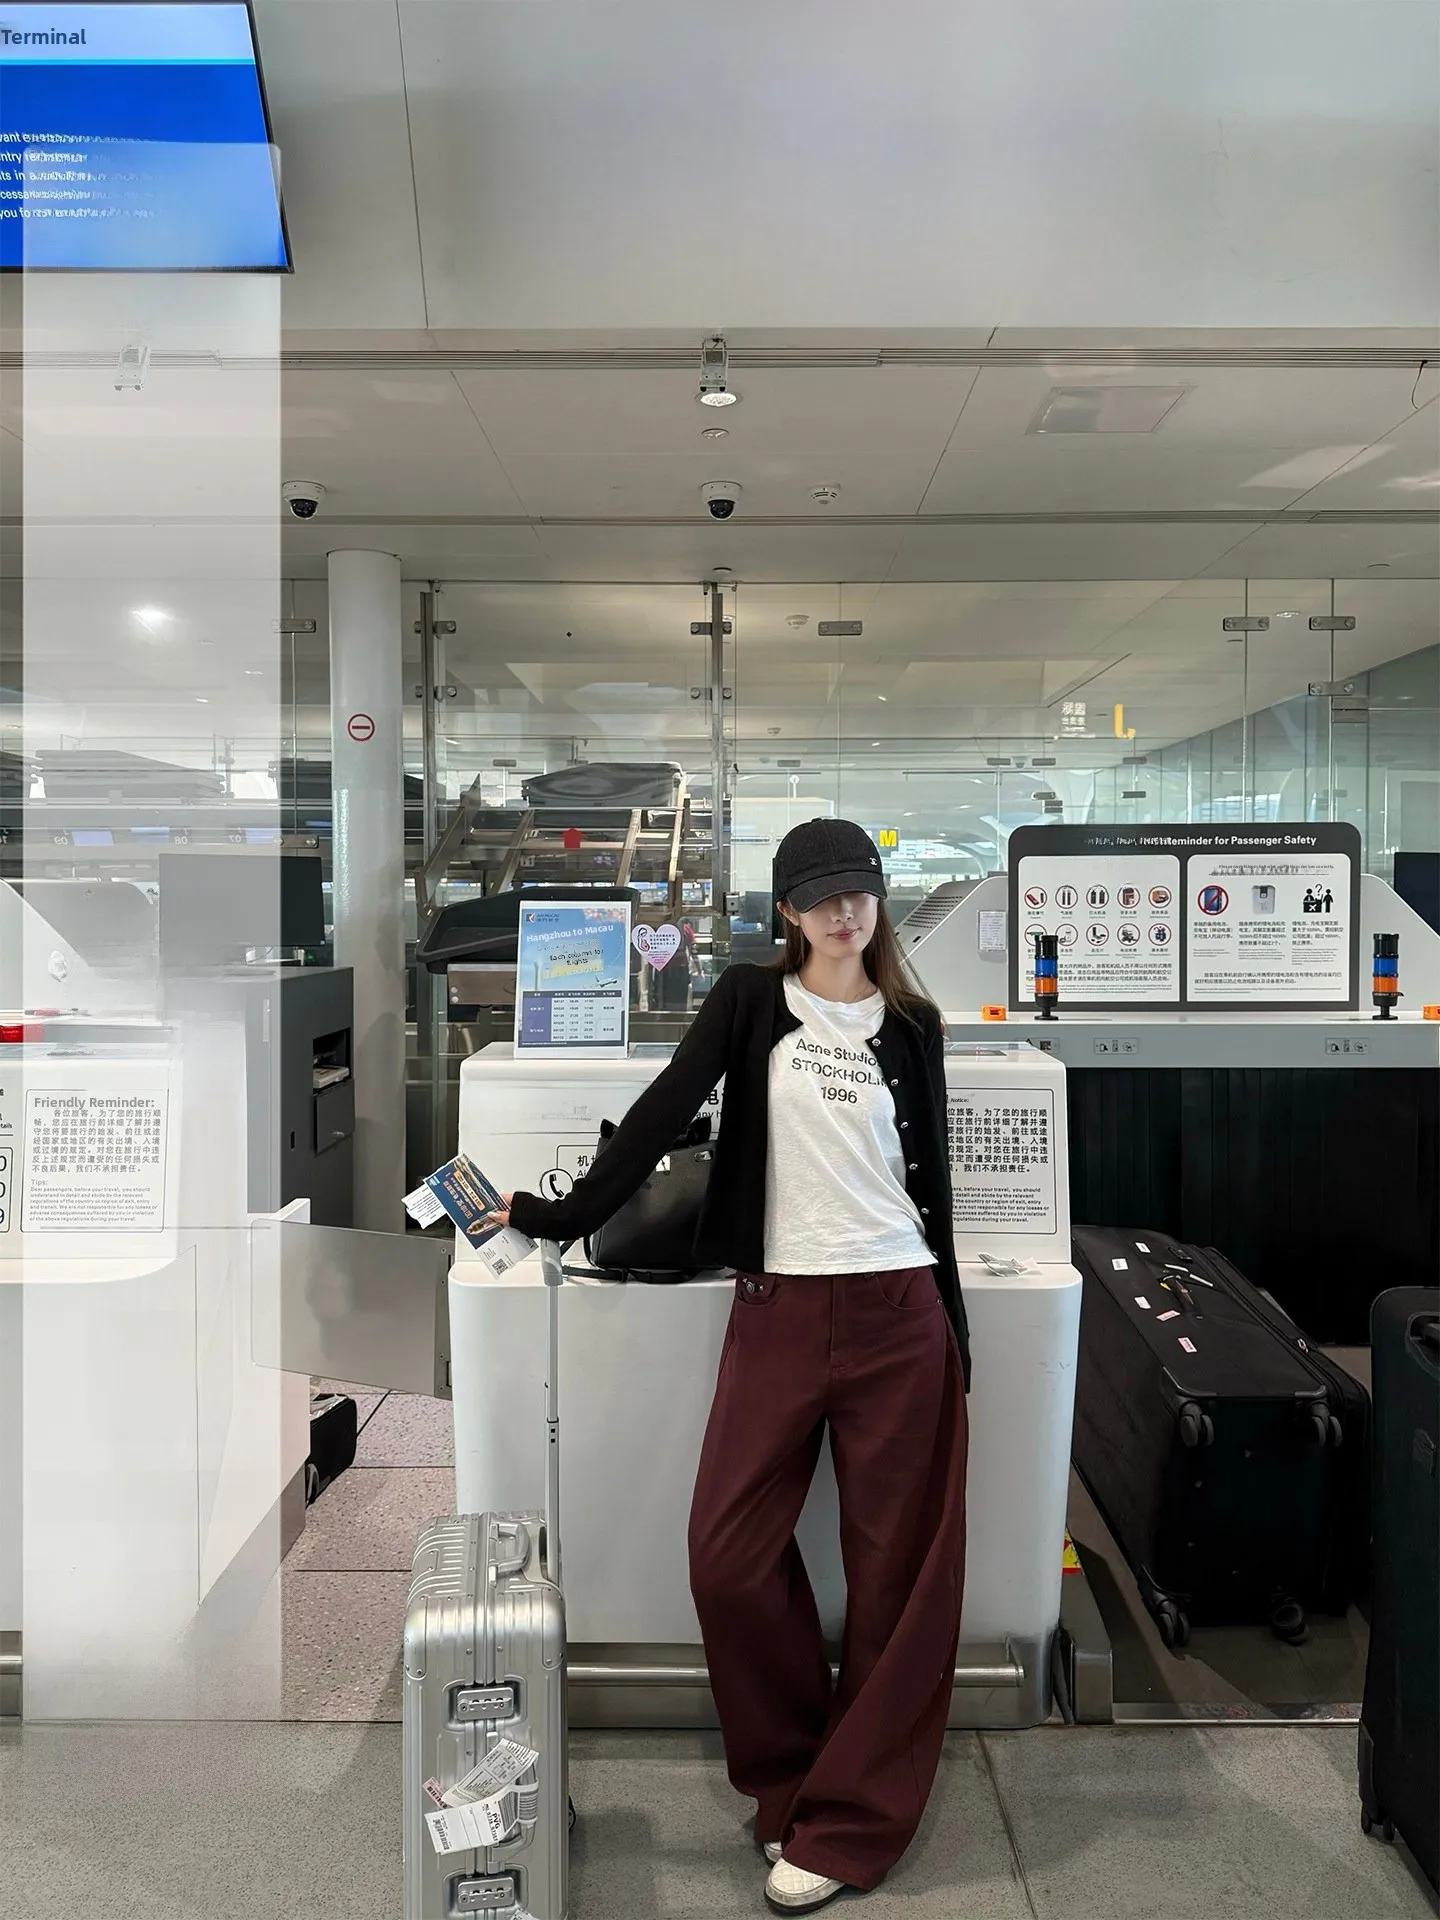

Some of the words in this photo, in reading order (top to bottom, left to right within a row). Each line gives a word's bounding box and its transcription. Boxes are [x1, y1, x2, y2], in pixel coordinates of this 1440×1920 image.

[2, 28, 86, 45] Terminal
[880, 830, 897, 847] M
[1214, 835, 1229, 846] for
[1230, 836, 1282, 849] Passenger
[1284, 834, 1317, 848] Safety
[526, 930, 571, 942] Hangzhou
[572, 928, 583, 936] to
[585, 924, 614, 935] Macau
[796, 1038, 832, 1056] Acne
[834, 1048, 880, 1066] Studio
[34, 1098, 85, 1110] Friendly
[89, 1097, 155, 1108] Reminder:
[820, 1086, 858, 1104] 1996
[492, 1812, 501, 1829] PVG
